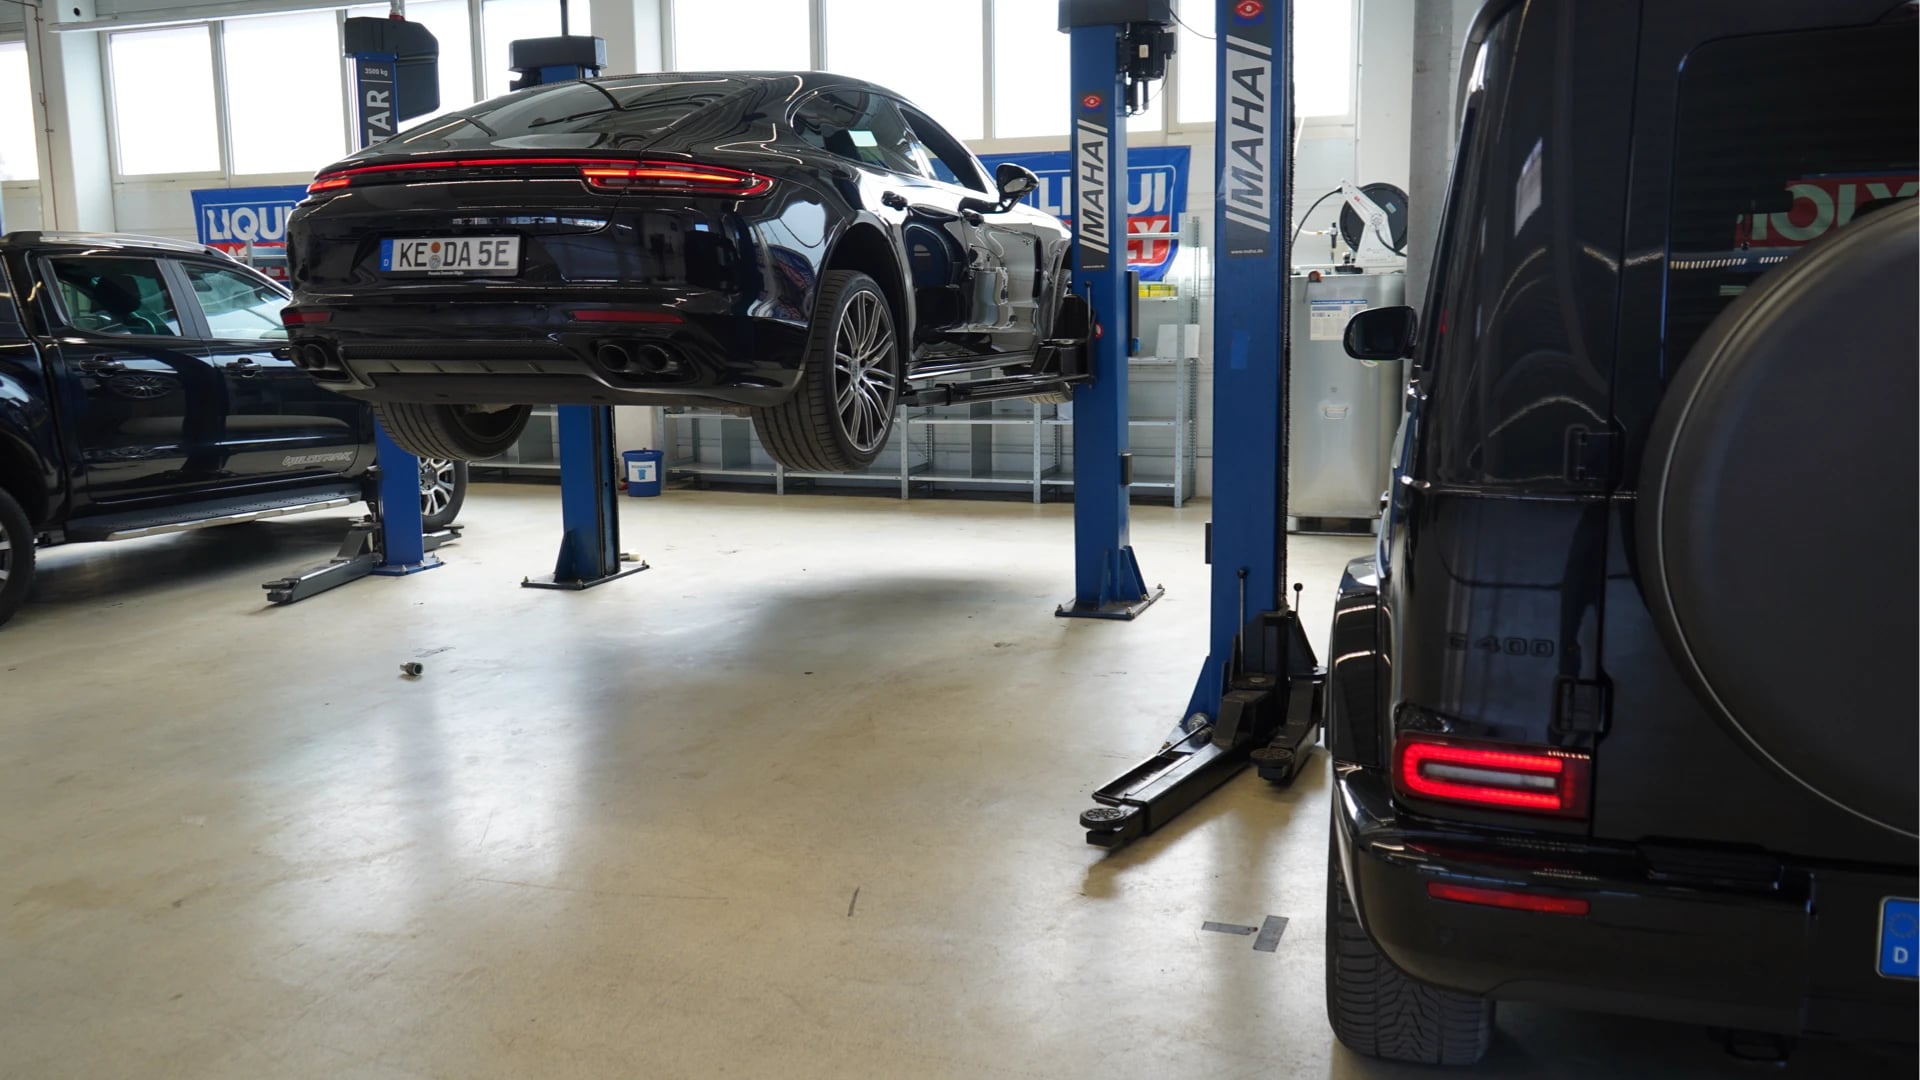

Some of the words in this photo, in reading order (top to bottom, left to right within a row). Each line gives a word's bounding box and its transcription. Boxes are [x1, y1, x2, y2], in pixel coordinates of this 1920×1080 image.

[380, 68, 388, 77] kg
[1231, 66, 1265, 210] MAHA
[1038, 172, 1167, 216] LIUI
[1082, 140, 1105, 238] MAHA
[399, 242, 428, 268] KE
[442, 241, 471, 267] DA
[478, 240, 510, 267] 5E
[1893, 946, 1909, 964] D
